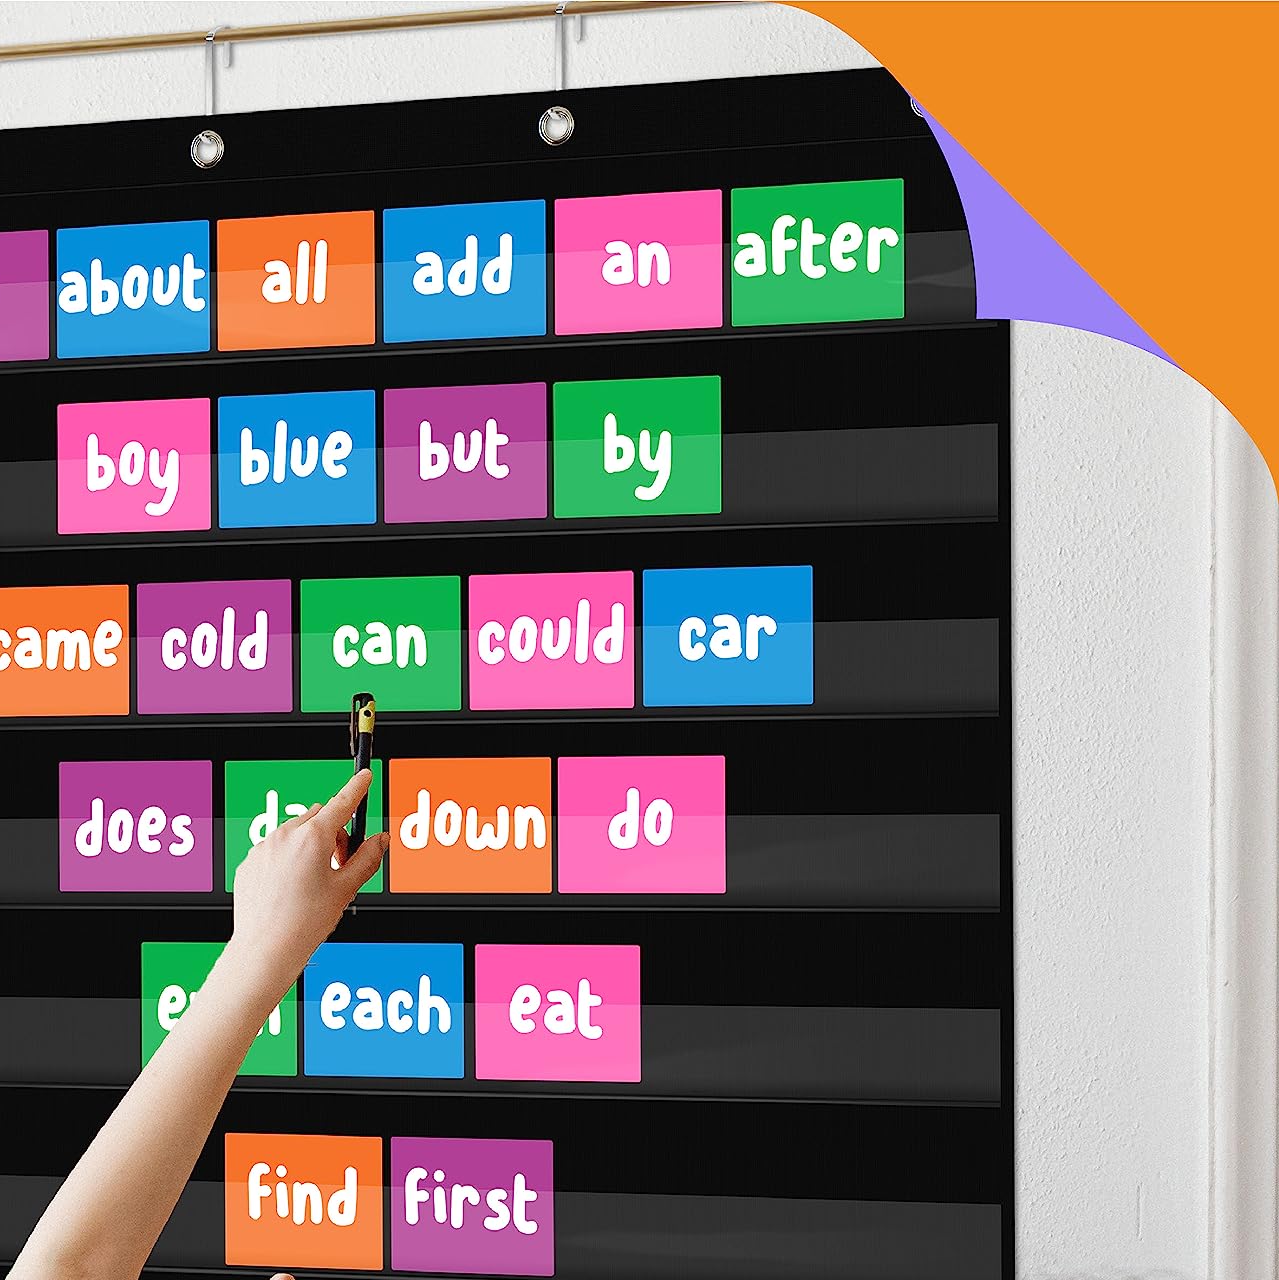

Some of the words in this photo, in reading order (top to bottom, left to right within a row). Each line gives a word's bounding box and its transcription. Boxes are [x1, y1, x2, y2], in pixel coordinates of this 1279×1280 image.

[58, 253, 206, 316] about
[262, 239, 328, 305] all
[413, 233, 513, 296] add
[602, 240, 671, 287] an
[733, 214, 899, 279] after
[87, 433, 179, 516] boy
[240, 420, 353, 486] blue
[419, 418, 510, 481] but
[604, 413, 672, 501] by
[161, 607, 268, 671] cold
[333, 621, 427, 668] can
[478, 599, 625, 665] could
[679, 614, 777, 661] car
[75, 798, 195, 857] does
[399, 789, 546, 851] down
[608, 787, 673, 849] do
[320, 974, 451, 1034] each
[509, 978, 603, 1040] eat
[248, 1163, 357, 1226] find
[405, 1167, 538, 1235] first
